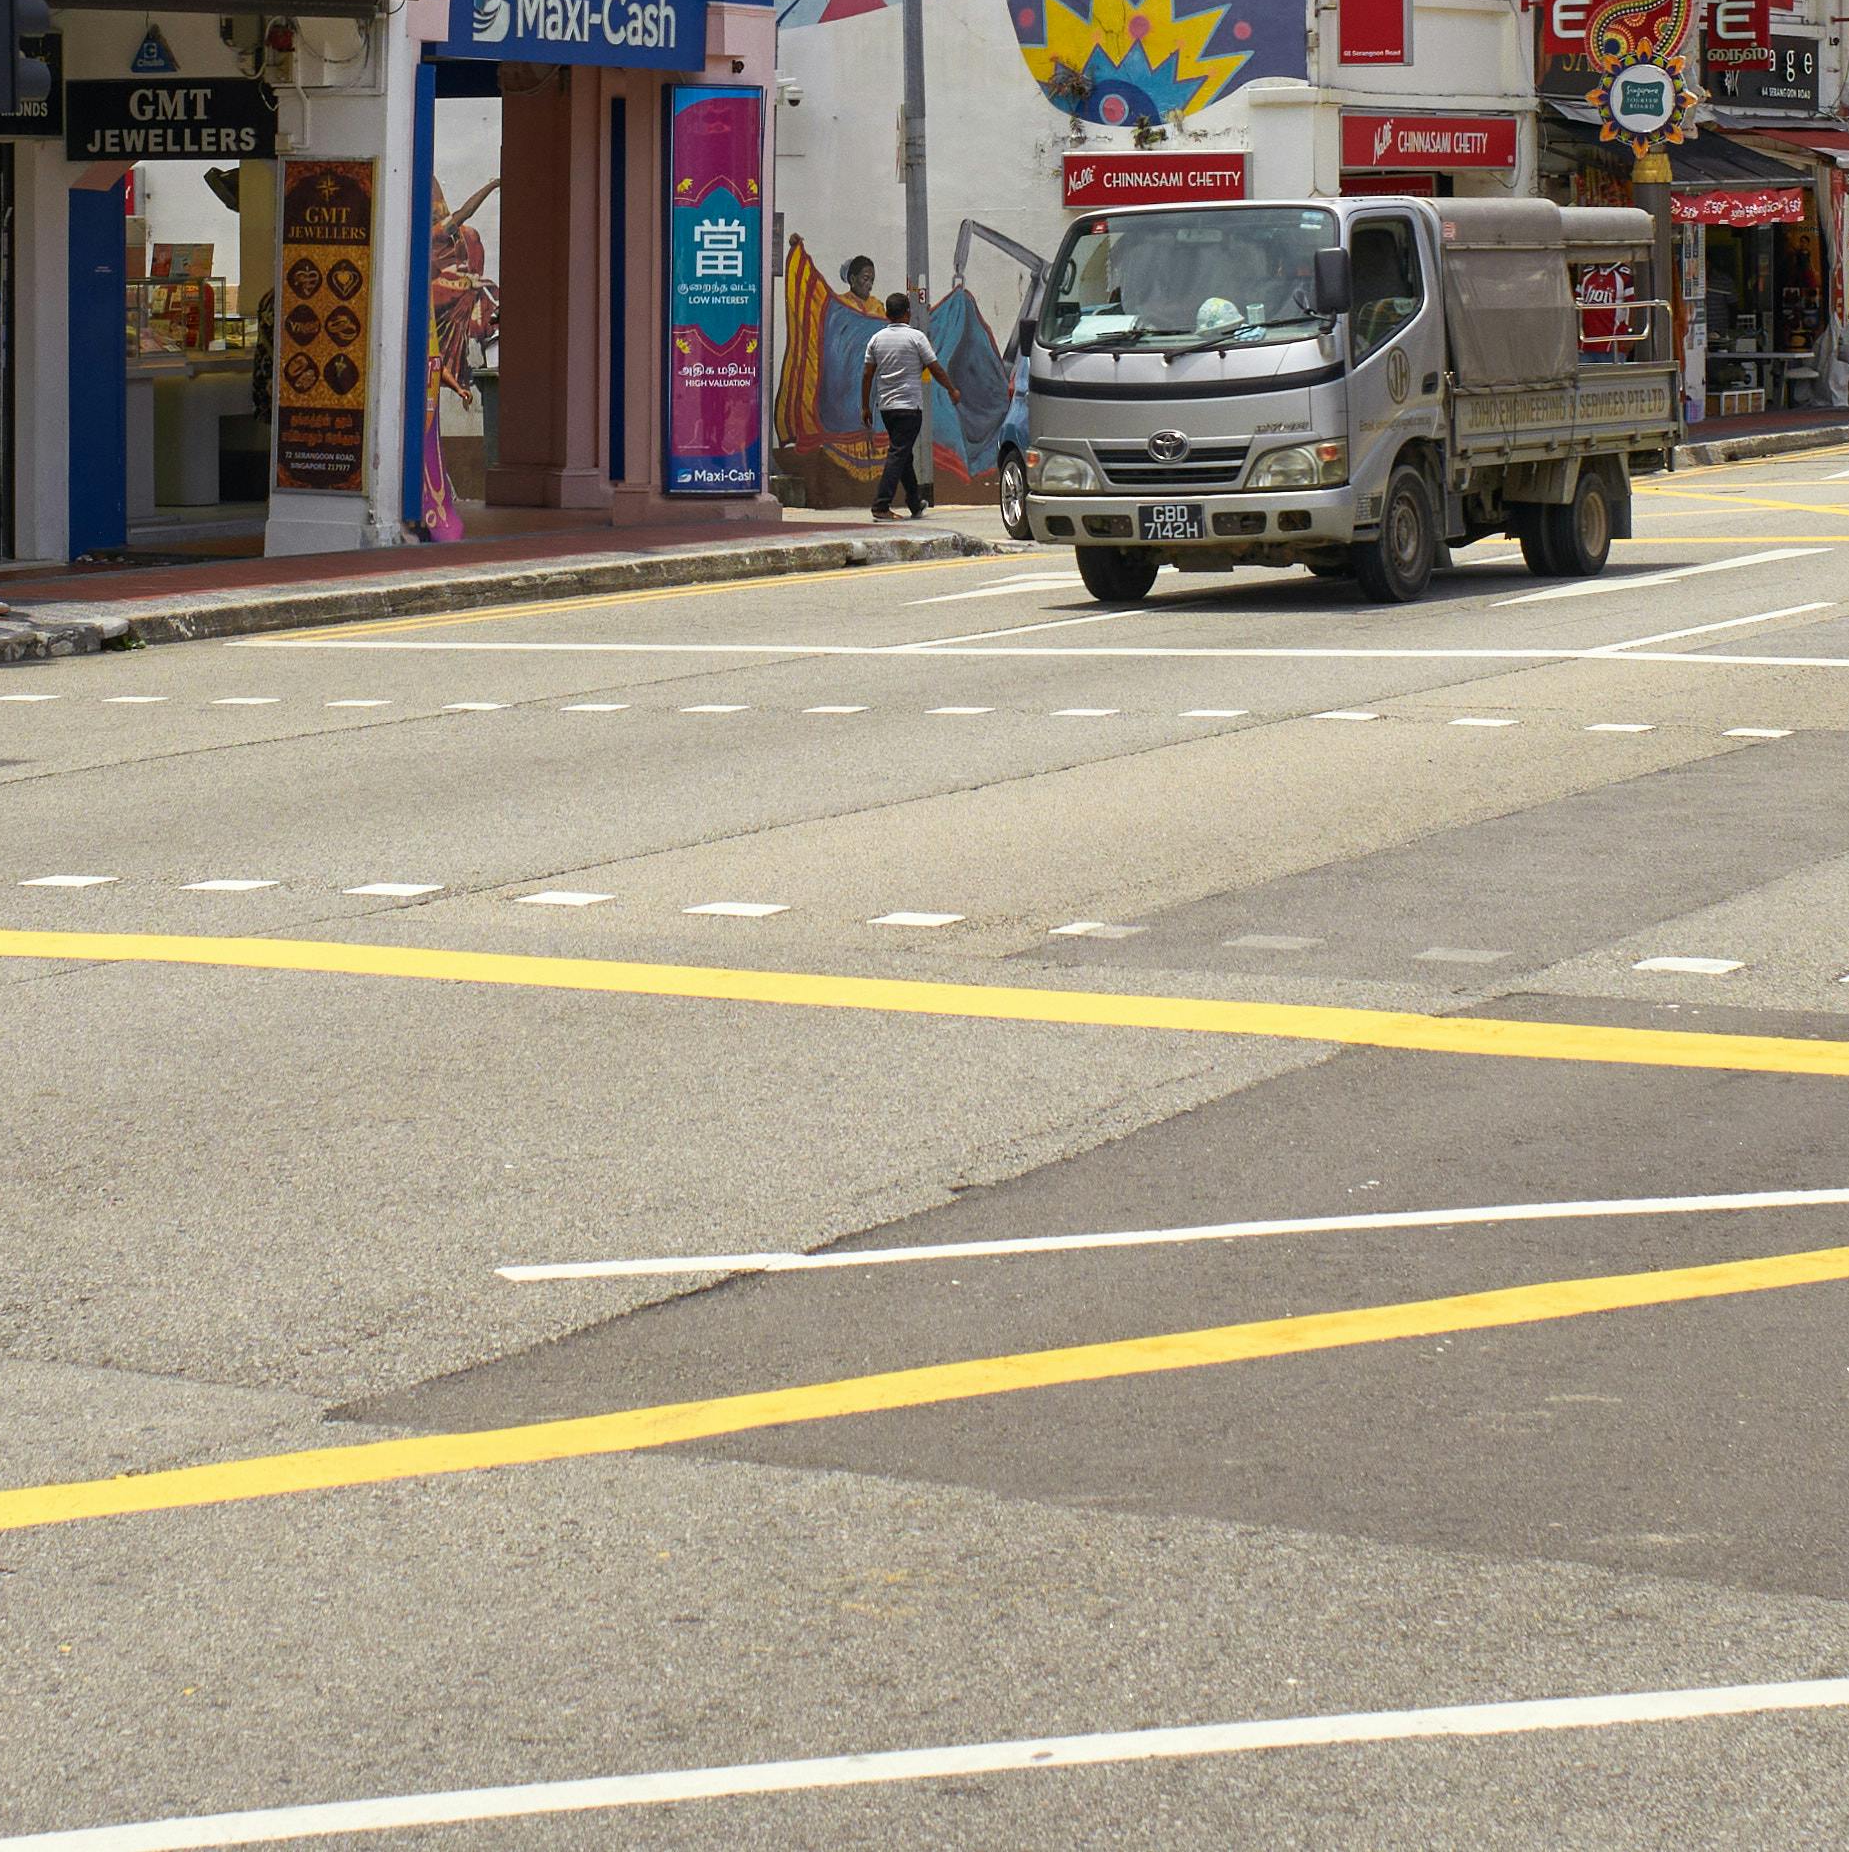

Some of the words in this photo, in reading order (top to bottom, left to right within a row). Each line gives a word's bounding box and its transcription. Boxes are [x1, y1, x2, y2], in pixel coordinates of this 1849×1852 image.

[1352, 50, 1384, 58] Serangoon
[1385, 49, 1401, 57] Road
[129, 88, 212, 121] GMT
[87, 127, 257, 154] JEWELLERS
[1371, 122, 1394, 165] Nalli
[1398, 130, 1451, 154] CHINNASAMI
[1453, 131, 1488, 154] CHETTY
[1067, 167, 1095, 196] Nalli
[1103, 171, 1183, 188] CHINNASAMI
[1187, 171, 1242, 188] CHETTY
[305, 206, 351, 224] GMT
[288, 225, 366, 241] JEWELLERS
[693, 218, 746, 278] 當
[688, 295, 712, 305] LOW
[712, 295, 750, 305] INTEREST
[685, 378, 708, 388] HIGH
[709, 378, 752, 388] VALUATION
[1499, 395, 1566, 426] ENGINEERING
[1579, 391, 1626, 420] SERVICES
[1627, 389, 1647, 415] PTE
[1648, 387, 1666, 413] LTD
[694, 468, 756, 484] Maxi-Cash
[1152, 505, 1189, 523] GBD
[1143, 521, 1199, 540] 7142H
